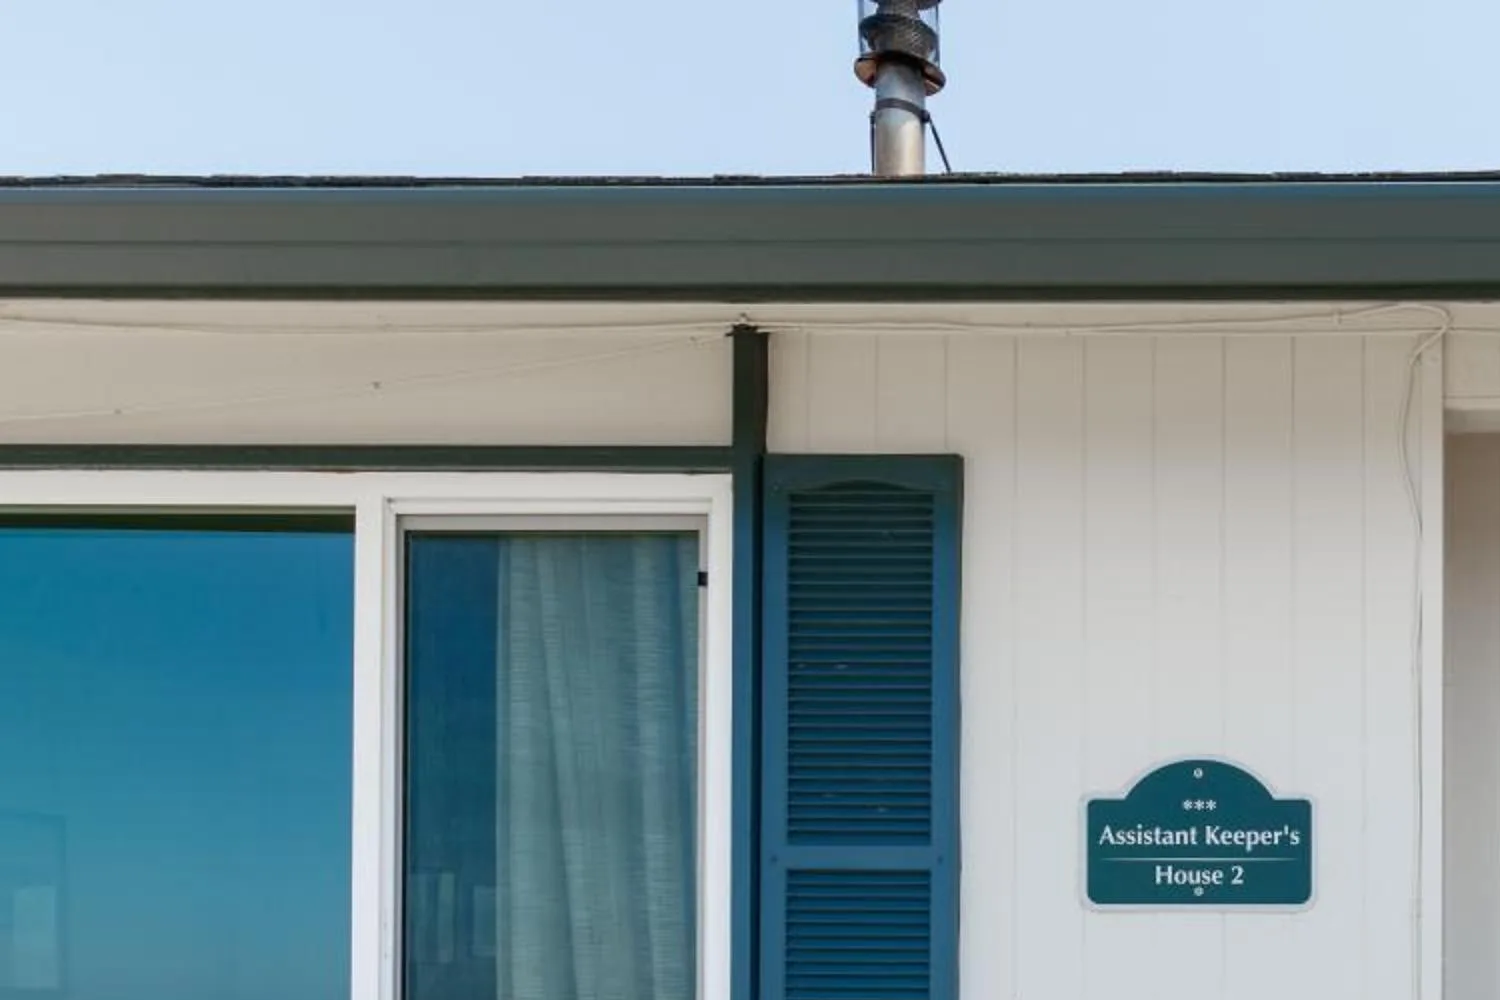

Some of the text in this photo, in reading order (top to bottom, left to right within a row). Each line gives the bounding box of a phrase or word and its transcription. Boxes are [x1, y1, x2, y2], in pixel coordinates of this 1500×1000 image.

[1099, 824, 1301, 852] Assistant Keeper's
[1154, 865, 1245, 886] House 2
